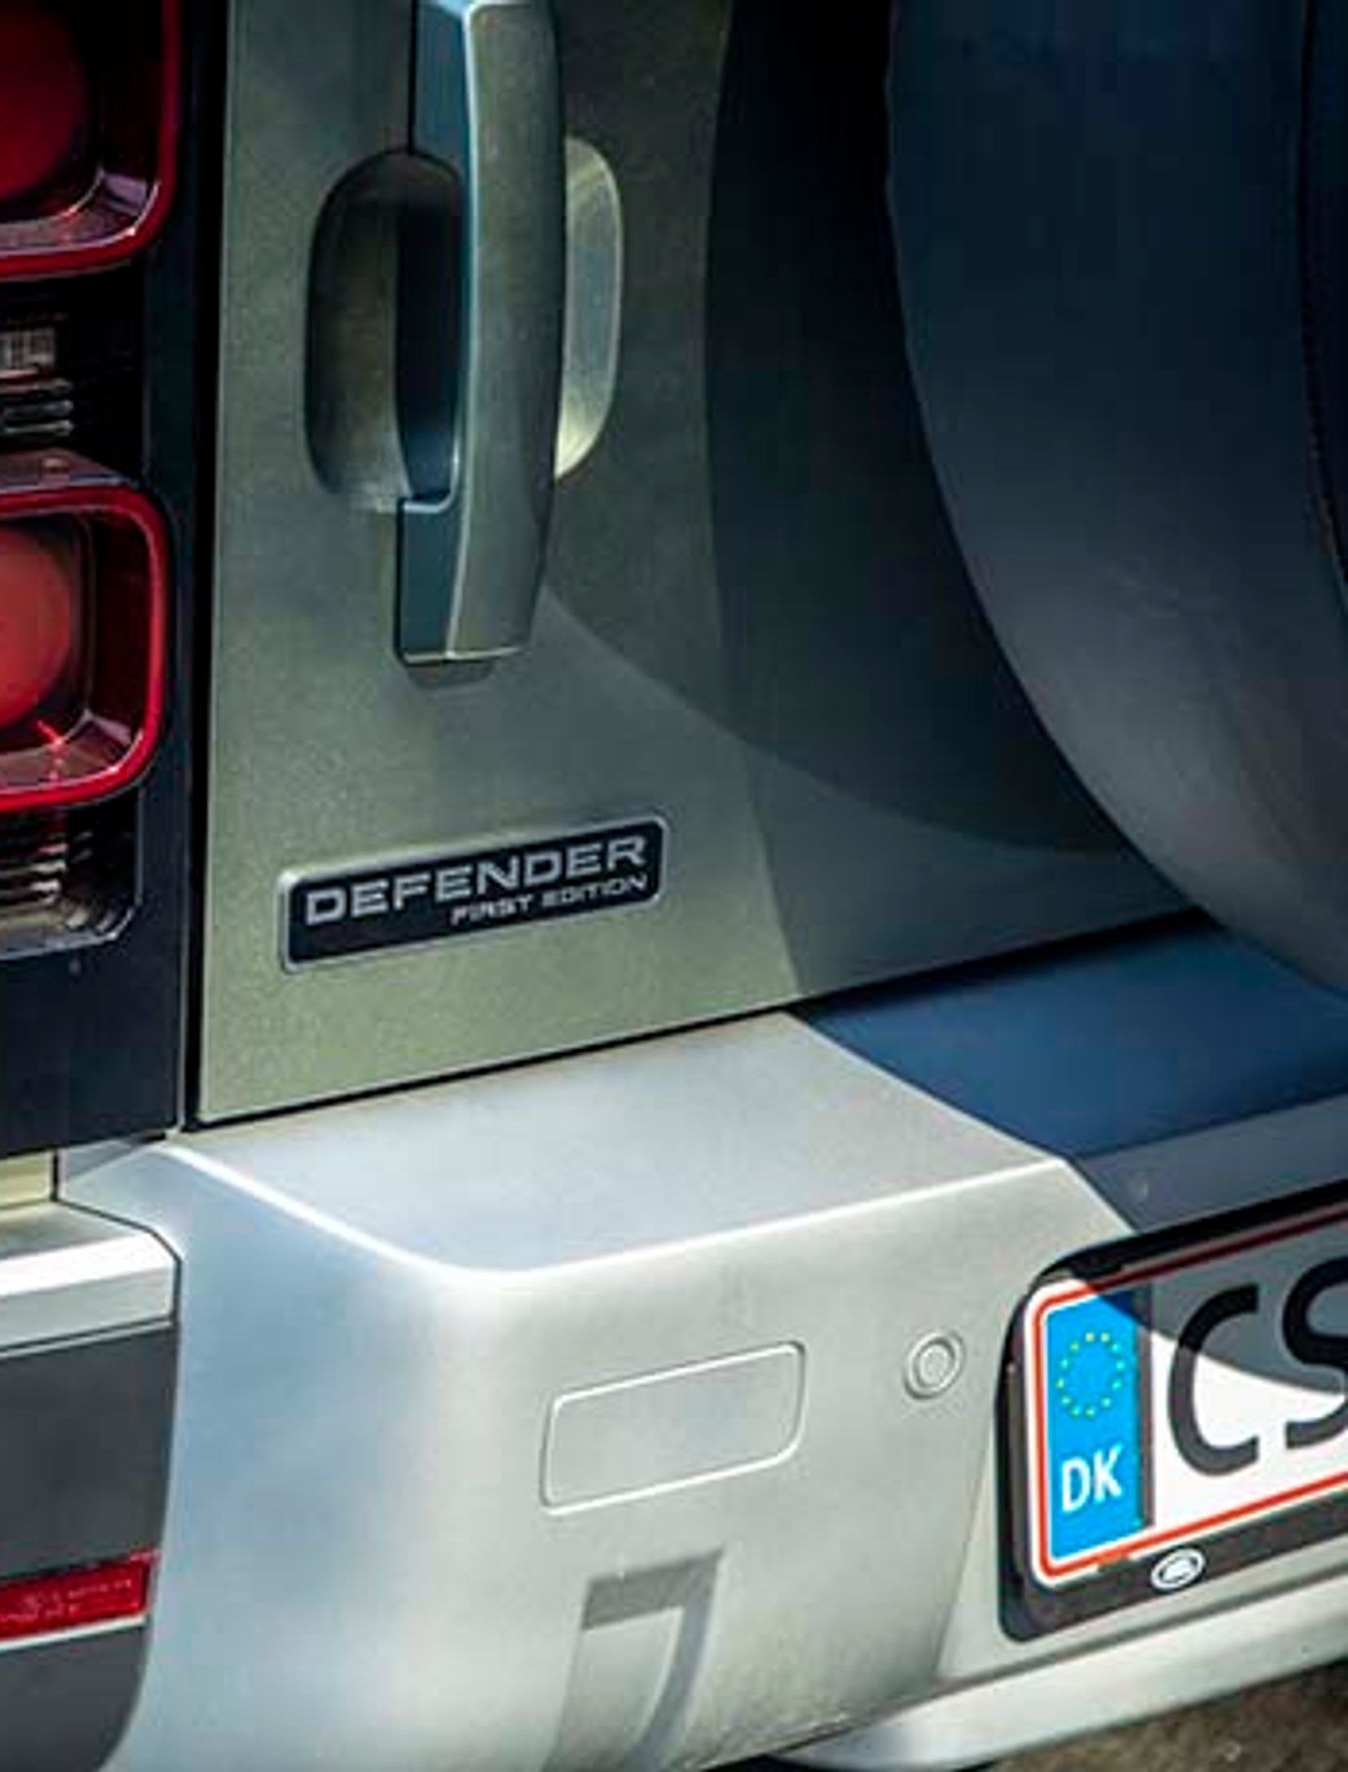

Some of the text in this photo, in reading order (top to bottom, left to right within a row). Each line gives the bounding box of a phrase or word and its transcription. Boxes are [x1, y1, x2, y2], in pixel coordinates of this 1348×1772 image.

[305, 835, 646, 926] DEFENDER
[451, 873, 648, 927] FIRST EDITION
[1061, 1445, 1124, 1513] DK
